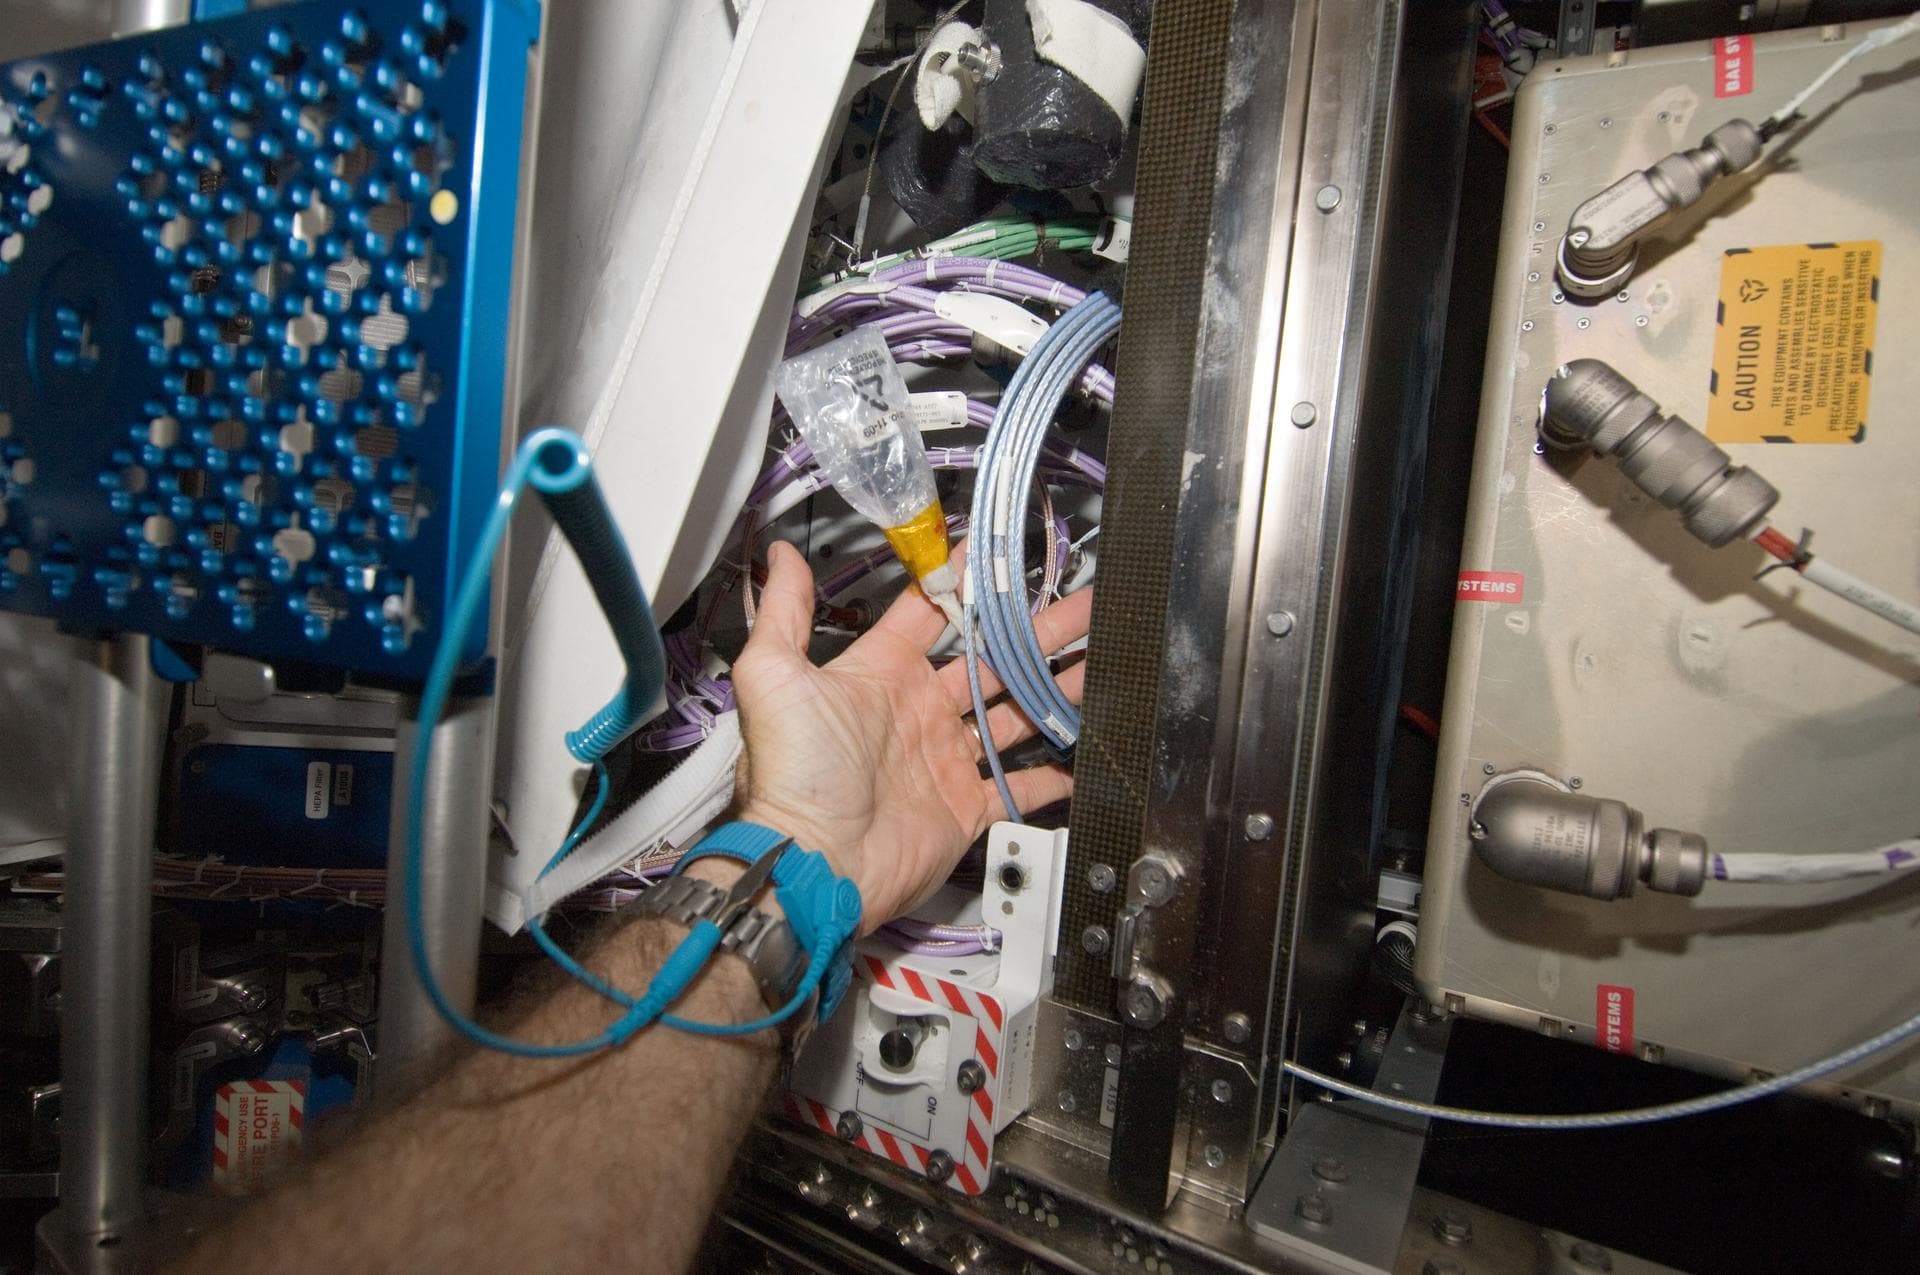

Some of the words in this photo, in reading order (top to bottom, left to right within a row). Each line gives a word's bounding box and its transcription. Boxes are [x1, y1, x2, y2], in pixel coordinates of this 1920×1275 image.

[1724, 58, 1741, 93] BAE
[1844, 250, 1857, 280] WHEN
[1856, 250, 1872, 302] INSERTING
[1797, 258, 1811, 307] SENSITIVE
[1828, 275, 1840, 294] ESD
[1780, 278, 1794, 326] CONTAINS
[1808, 267, 1825, 343] ELECTROSTATIC
[1826, 297, 1838, 316] USE
[1837, 283, 1854, 347] PROCEDURES
[1853, 305, 1866, 319] OR
[1774, 329, 1788, 383] EQUIPMENT
[1790, 310, 1806, 371] ASSEMBLIES
[1807, 346, 1818, 358] BY
[1850, 322, 1866, 374] REMOVING
[1732, 325, 1762, 412] CAUTION
[1788, 373, 1800, 393] AND
[1802, 361, 1816, 400] DAMAGE
[1816, 353, 1832, 408] DISCHARGE
[1771, 385, 1783, 408] THIS
[1828, 350, 1847, 432] PRECAUTIONARY
[1785, 396, 1798, 426] PARTS
[1801, 403, 1812, 416] TO
[314, 768, 324, 789] Filter
[312, 790, 322, 812] HEPA
[1460, 793, 1471, 807] J3
[239, 1096, 249, 1116] USE
[253, 1096, 268, 1140] PORT
[927, 1096, 938, 1116] ON
